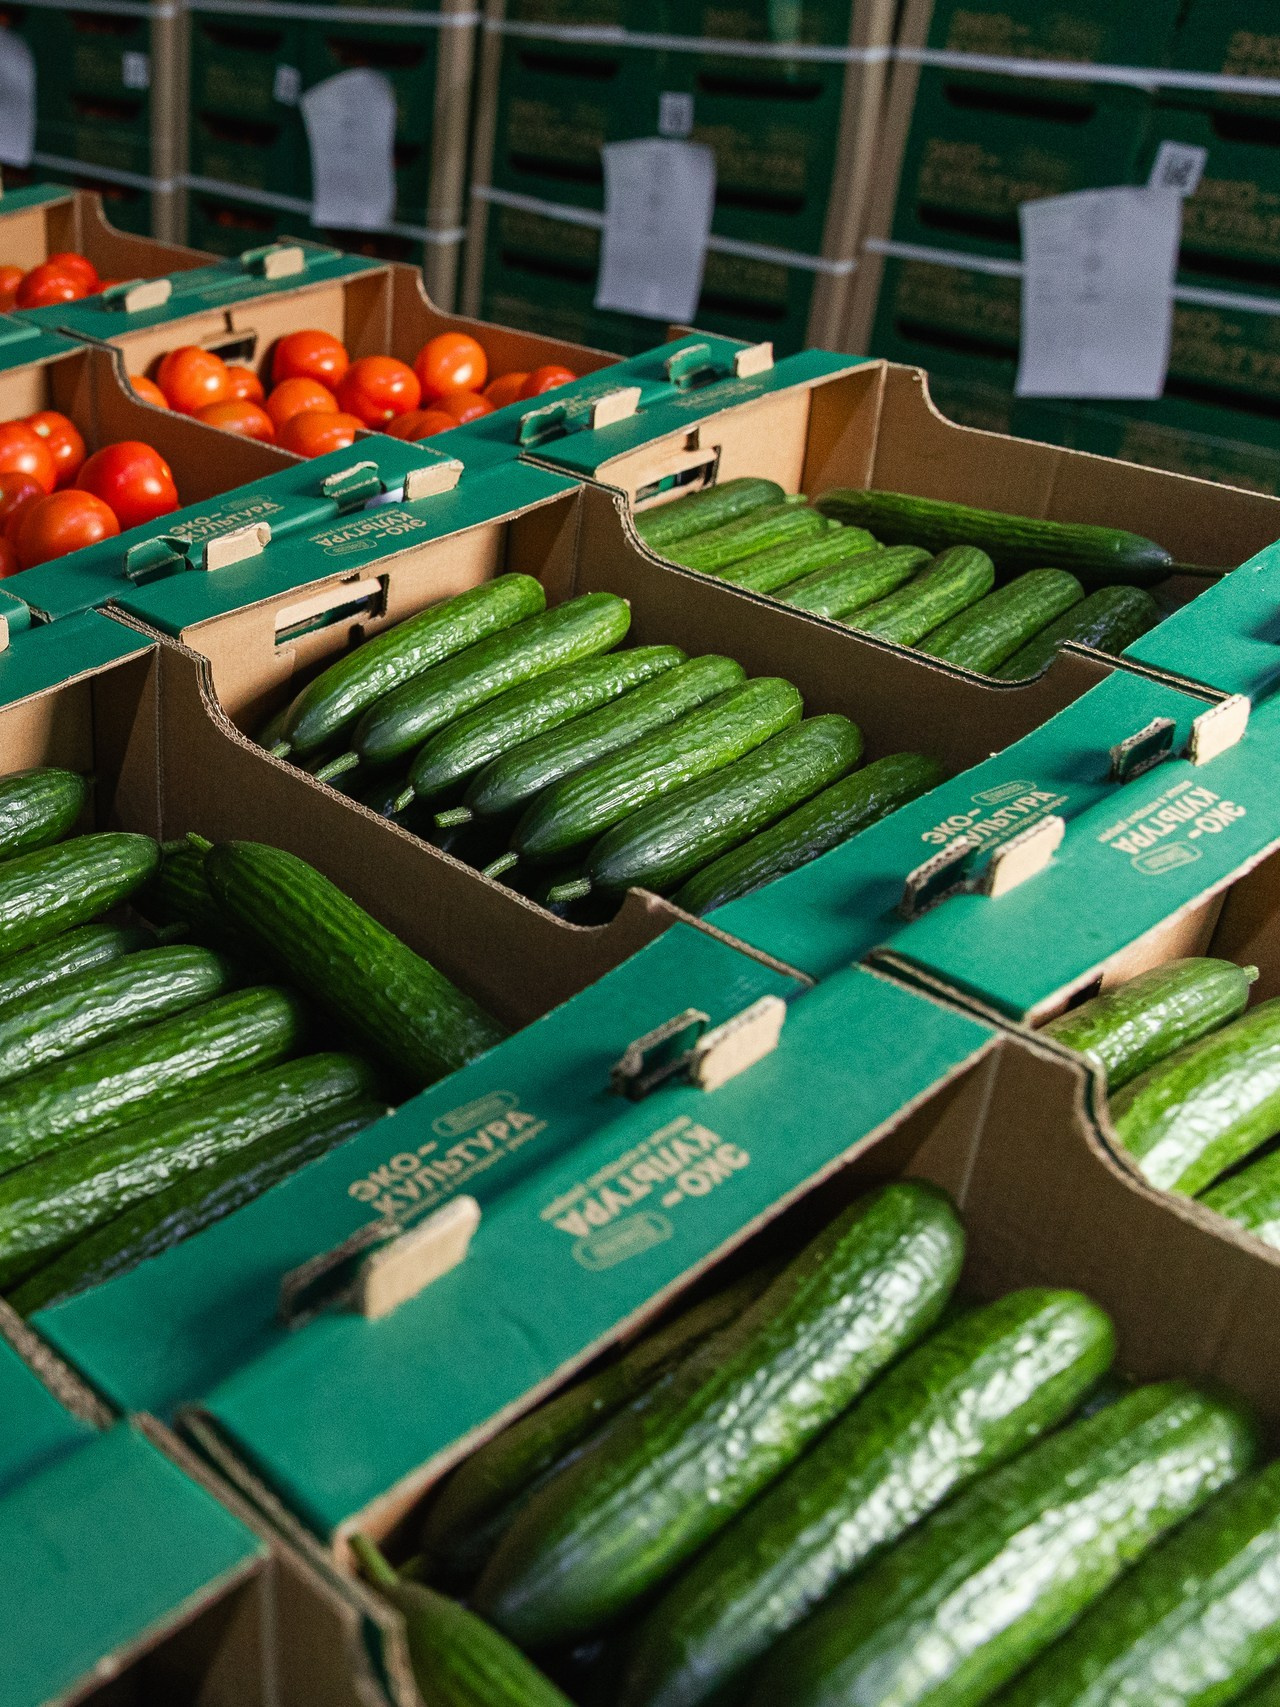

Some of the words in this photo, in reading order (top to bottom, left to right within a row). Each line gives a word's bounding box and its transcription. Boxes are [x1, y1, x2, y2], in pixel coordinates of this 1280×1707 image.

[316, 512, 413, 546] КУЛЬТУРА
[921, 808, 981, 844] ЭКО-
[946, 791, 1057, 849] УЛЬТУРА
[1110, 786, 1220, 854] КУЛЬТУРА
[1187, 801, 1246, 840] ЭКО-
[348, 1140, 439, 1202] ЭКО-
[371, 1109, 536, 1219] КУЛЬТУРА
[554, 1124, 721, 1237] КУЛЬТУРА
[661, 1142, 751, 1208] ЭКО-
